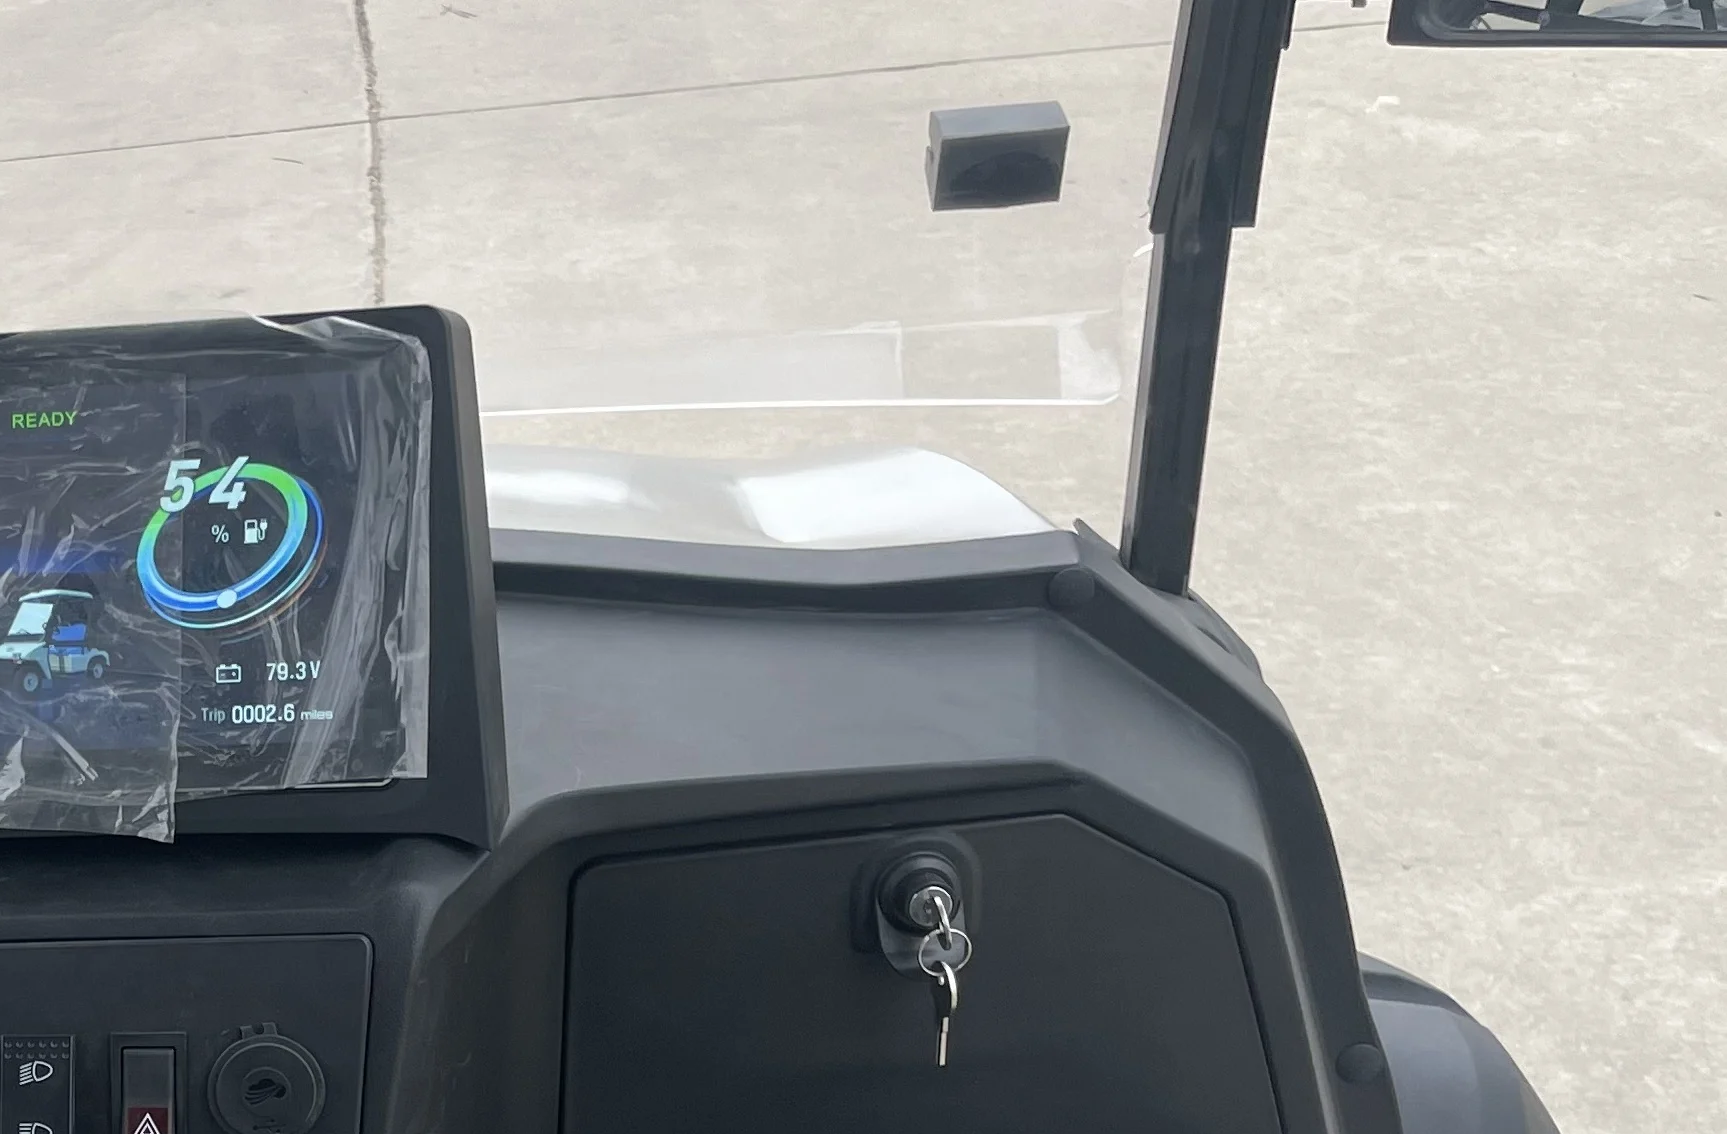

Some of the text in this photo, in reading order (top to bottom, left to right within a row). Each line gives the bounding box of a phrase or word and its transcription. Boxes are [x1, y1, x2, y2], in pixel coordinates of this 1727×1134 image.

[12, 410, 78, 429] READY
[160, 456, 249, 513] 54
[201, 703, 333, 724] Trip 0002.6 miles
